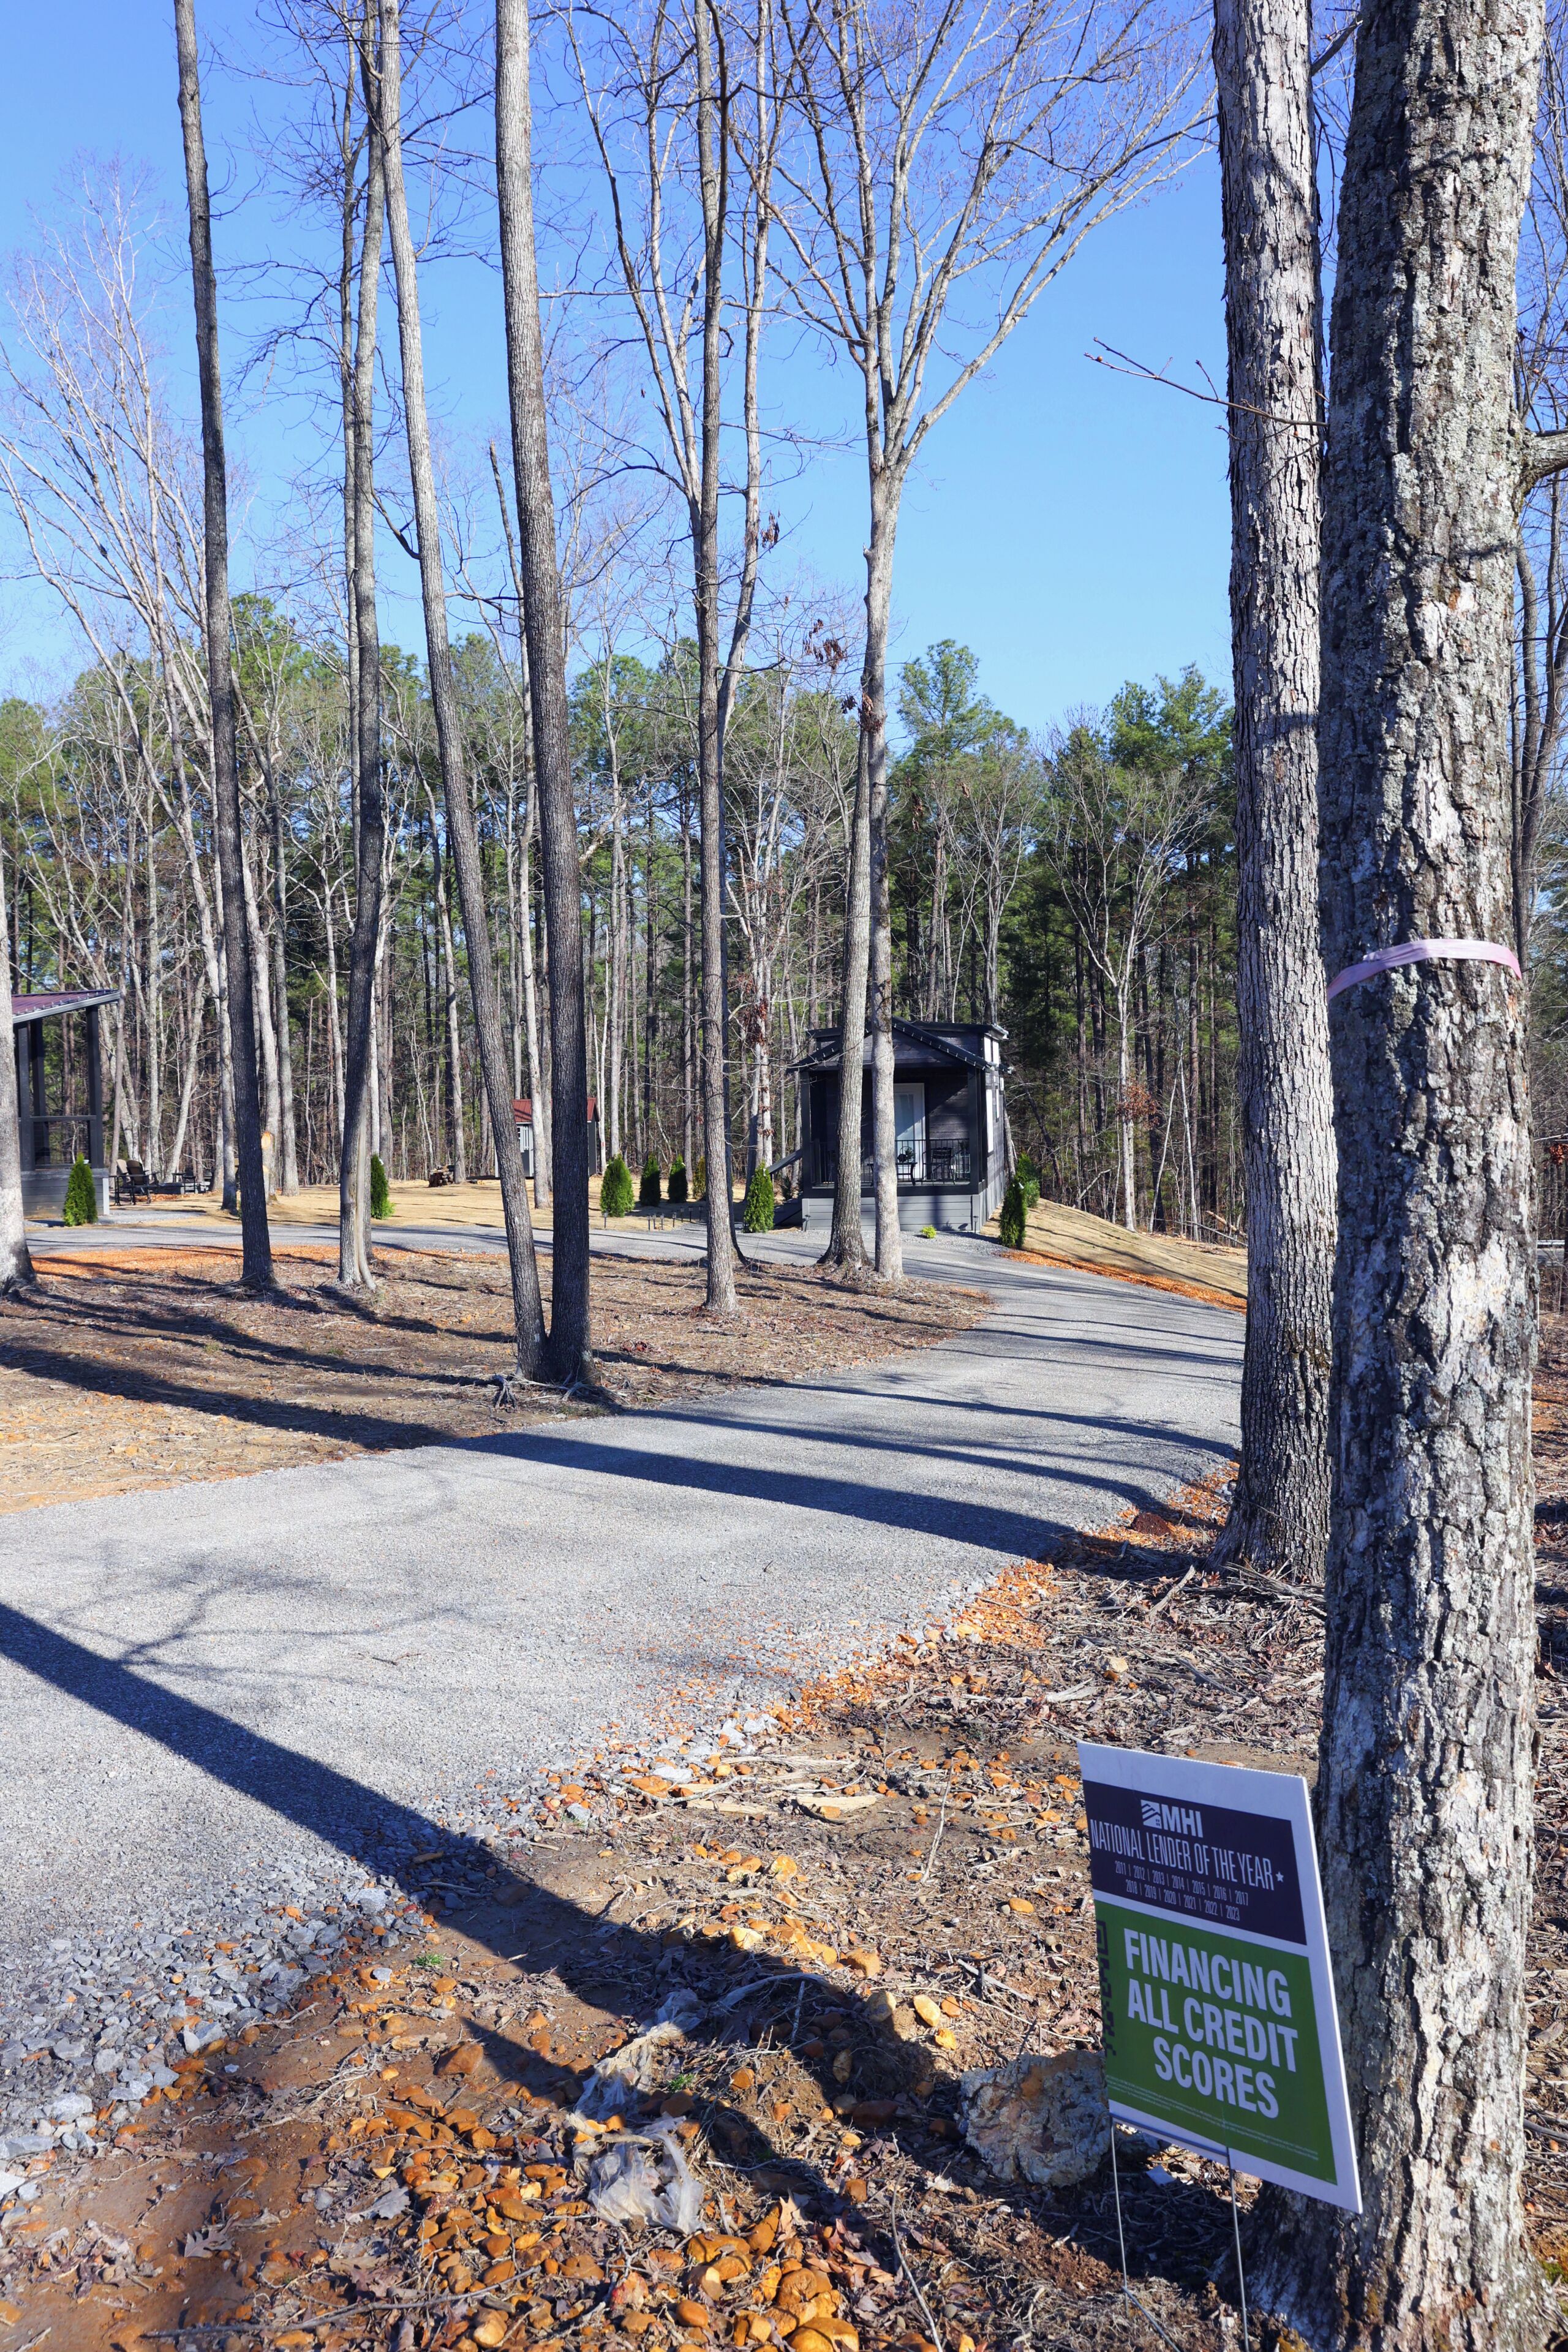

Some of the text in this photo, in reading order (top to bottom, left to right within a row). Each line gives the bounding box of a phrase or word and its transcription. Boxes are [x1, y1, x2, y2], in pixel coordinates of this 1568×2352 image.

[1090, 1819, 1274, 1891] NATIONAL LENDER OF THE YEAR
[1161, 1804, 1204, 1838] MHI
[1115, 1861, 1248, 1905] 2011 2012 2013 2014 2015 2016 2017
[1126, 1879, 1240, 1921] 2018 2019 2020 2021 2022 2023
[1124, 1929, 1292, 2018] FINANCING
[1128, 1979, 1298, 2072] ALL CREDIT
[1153, 2037, 1279, 2119] SCORES
